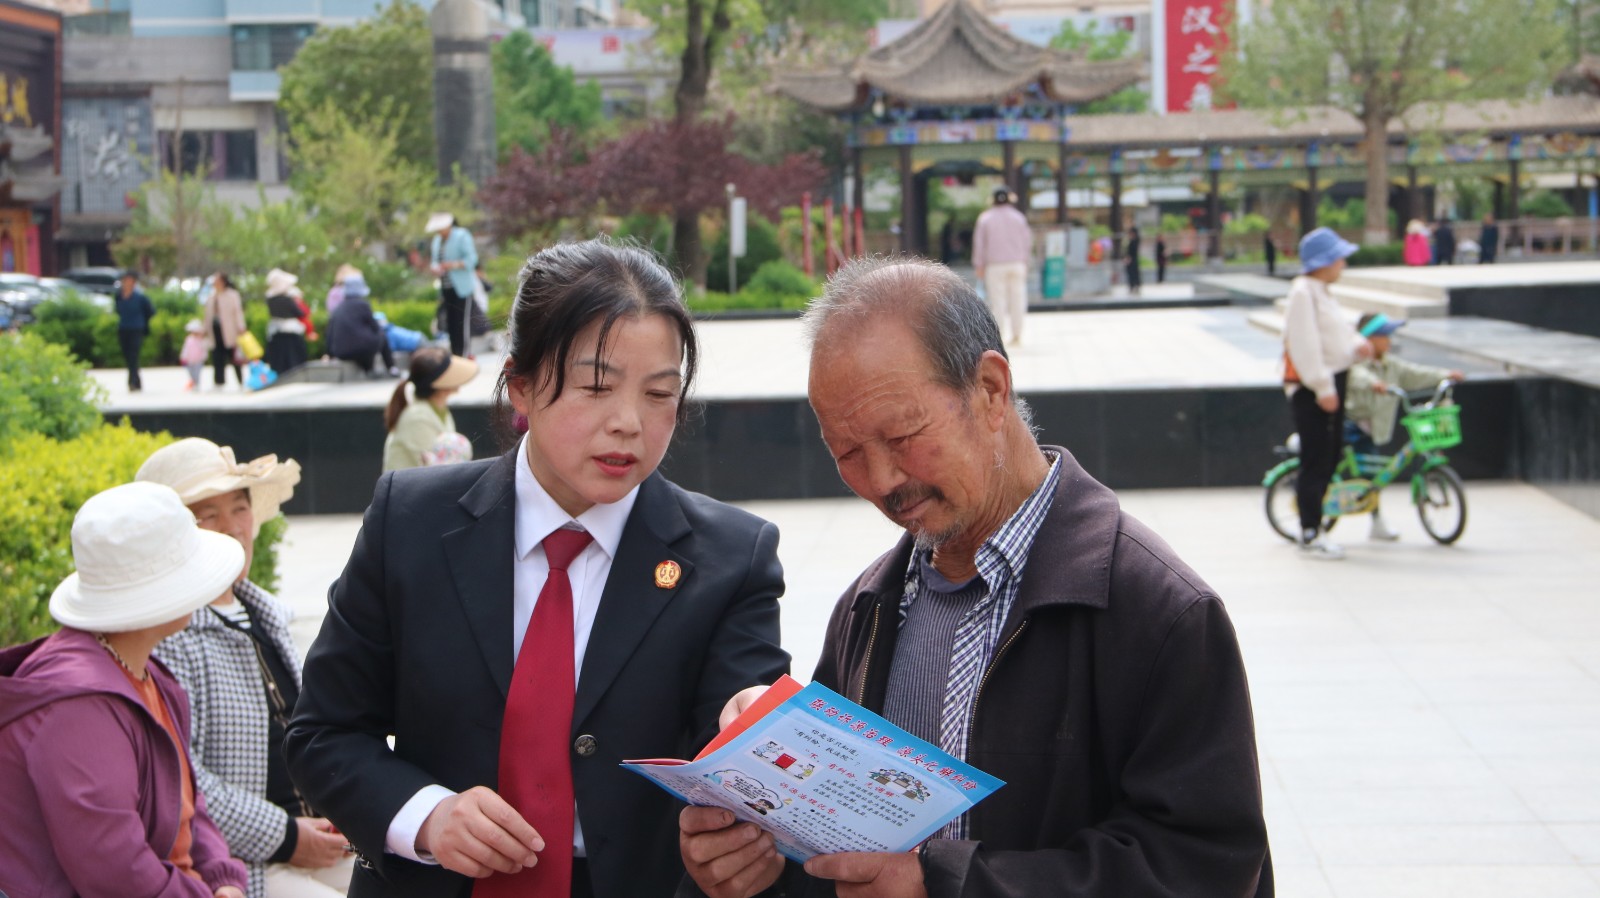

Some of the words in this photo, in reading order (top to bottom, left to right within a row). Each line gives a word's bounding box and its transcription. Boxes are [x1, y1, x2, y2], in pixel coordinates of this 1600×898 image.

[808, 698, 893, 746] 联动诉源治理
[895, 744, 978, 790] 源头化解纠纷
